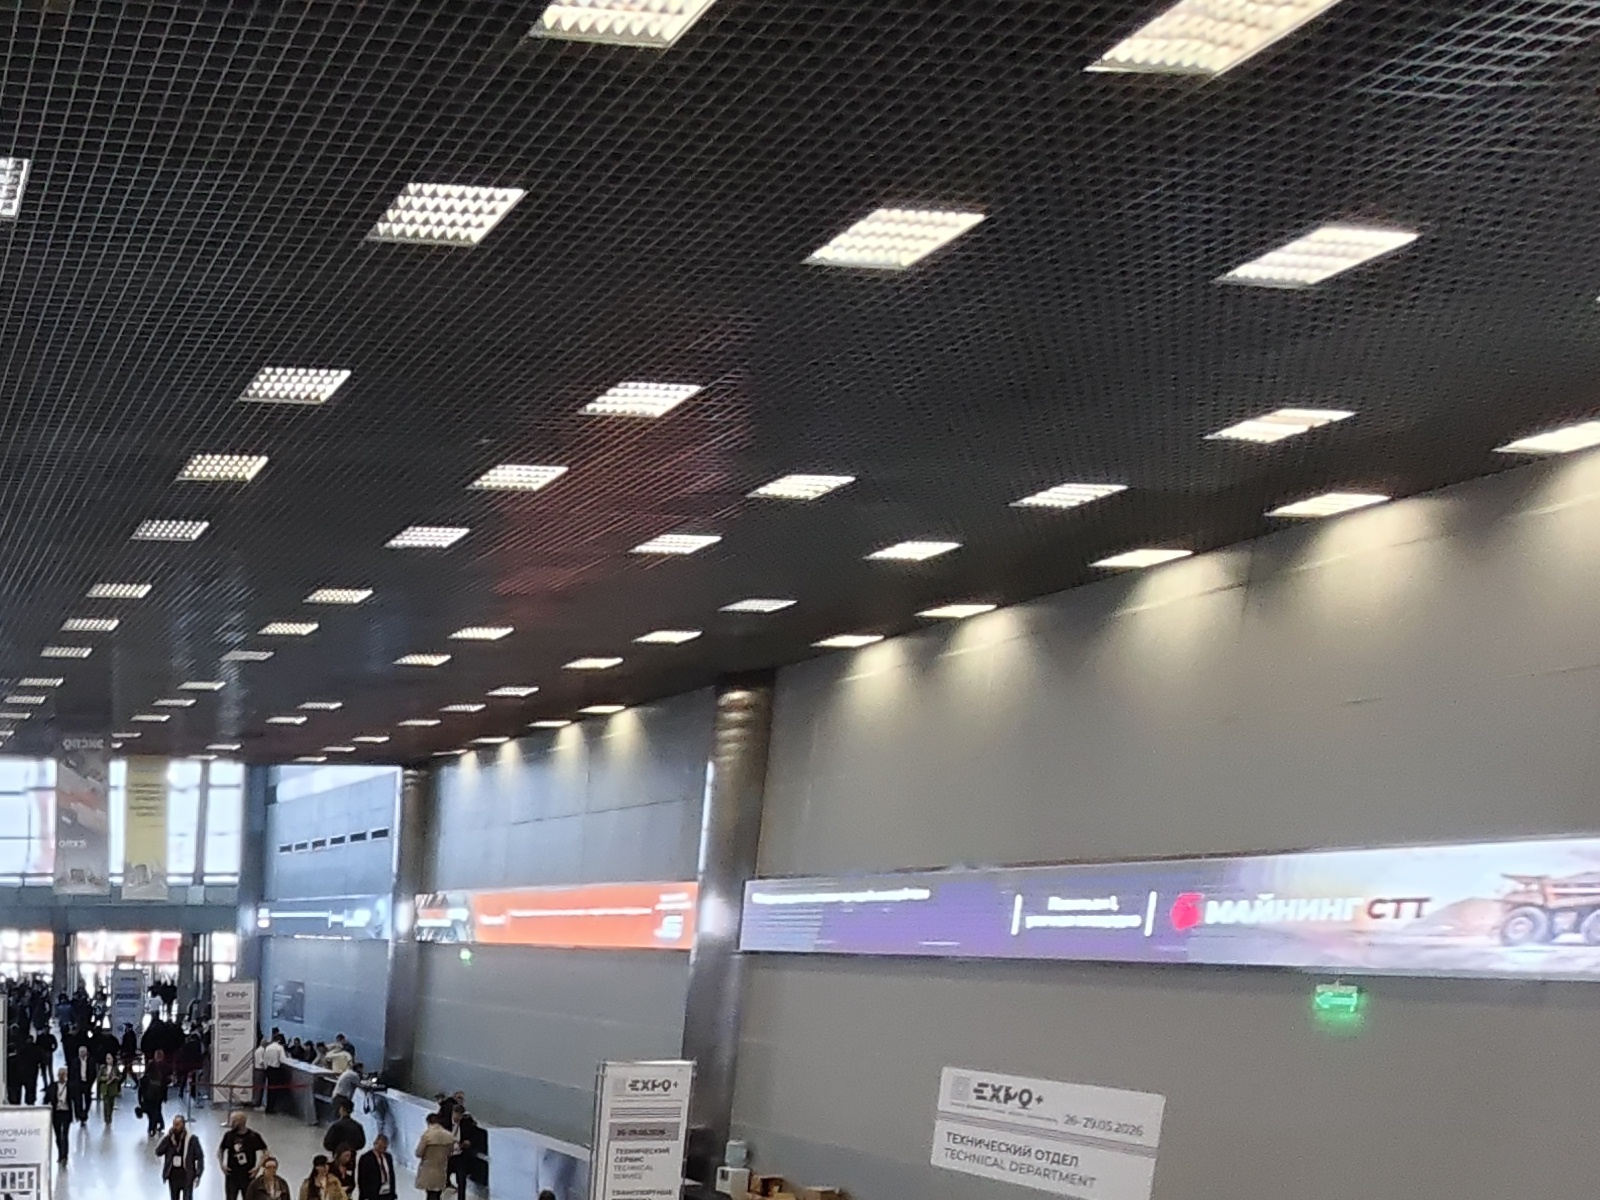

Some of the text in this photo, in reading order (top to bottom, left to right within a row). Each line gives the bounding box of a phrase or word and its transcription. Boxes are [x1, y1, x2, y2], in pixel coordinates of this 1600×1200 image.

[1204, 893, 1432, 924] МАЙНИНГ СТТ
[944, 1147, 1097, 1188] TECHNICAL DEPARTMENT
[946, 1131, 1080, 1168] ТЕХНИЧЕСКИЙ ОТДЕЛ
